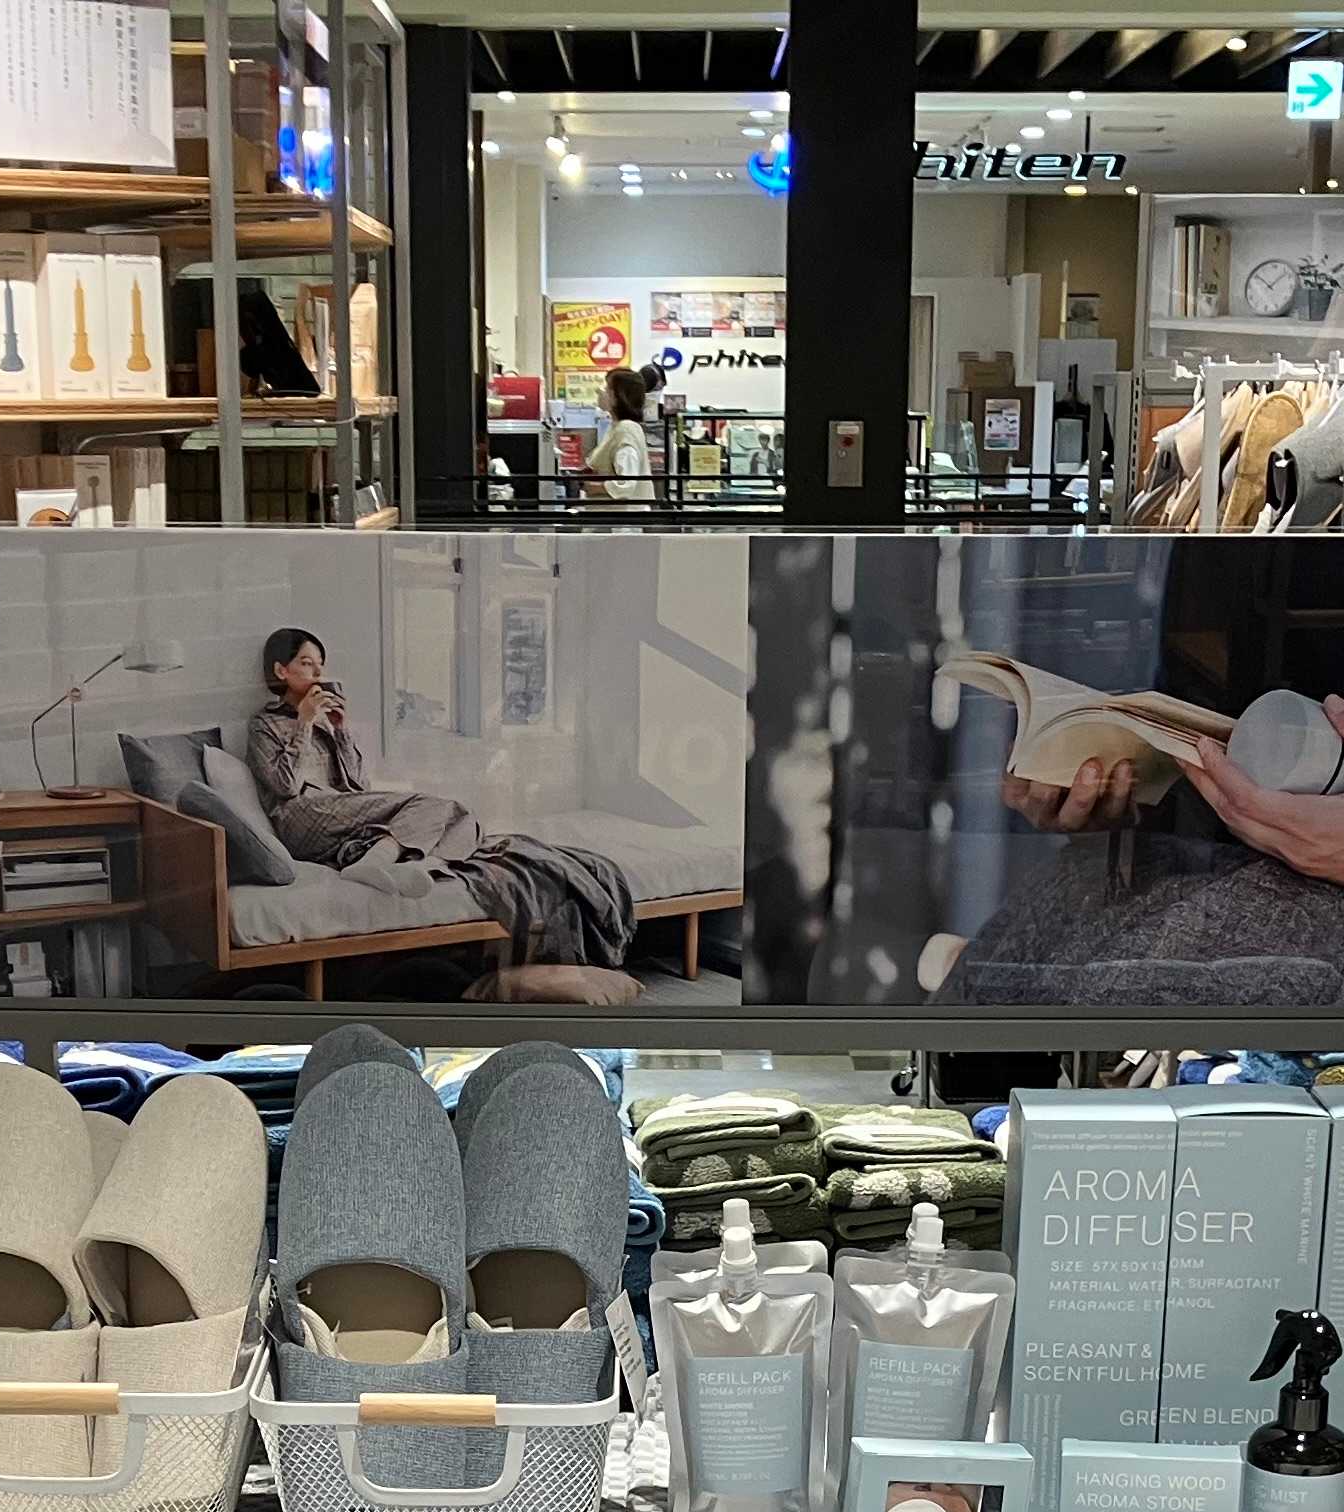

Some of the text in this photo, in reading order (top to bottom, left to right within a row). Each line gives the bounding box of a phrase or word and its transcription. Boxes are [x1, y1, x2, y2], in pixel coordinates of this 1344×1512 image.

[913, 141, 1127, 181] hiten
[687, 349, 786, 375] phite
[1043, 1167, 1201, 1202] AROMA
[1042, 1210, 1255, 1247] DIFFUSER
[1143, 1297, 1216, 1313] ETHANOL
[1025, 1342, 1153, 1359] PLEASANT &
[869, 1357, 961, 1376] REFILL PACK
[1023, 1363, 1207, 1382] SCENTFUL HOME
[697, 1369, 793, 1386] REFILL PACK
[1119, 1407, 1275, 1426] GREEN BLEND
[1075, 1471, 1226, 1491] HANGING WOOD
[1074, 1493, 1205, 1512] AROMA STONE
[1270, 1490, 1308, 1504] MIST
